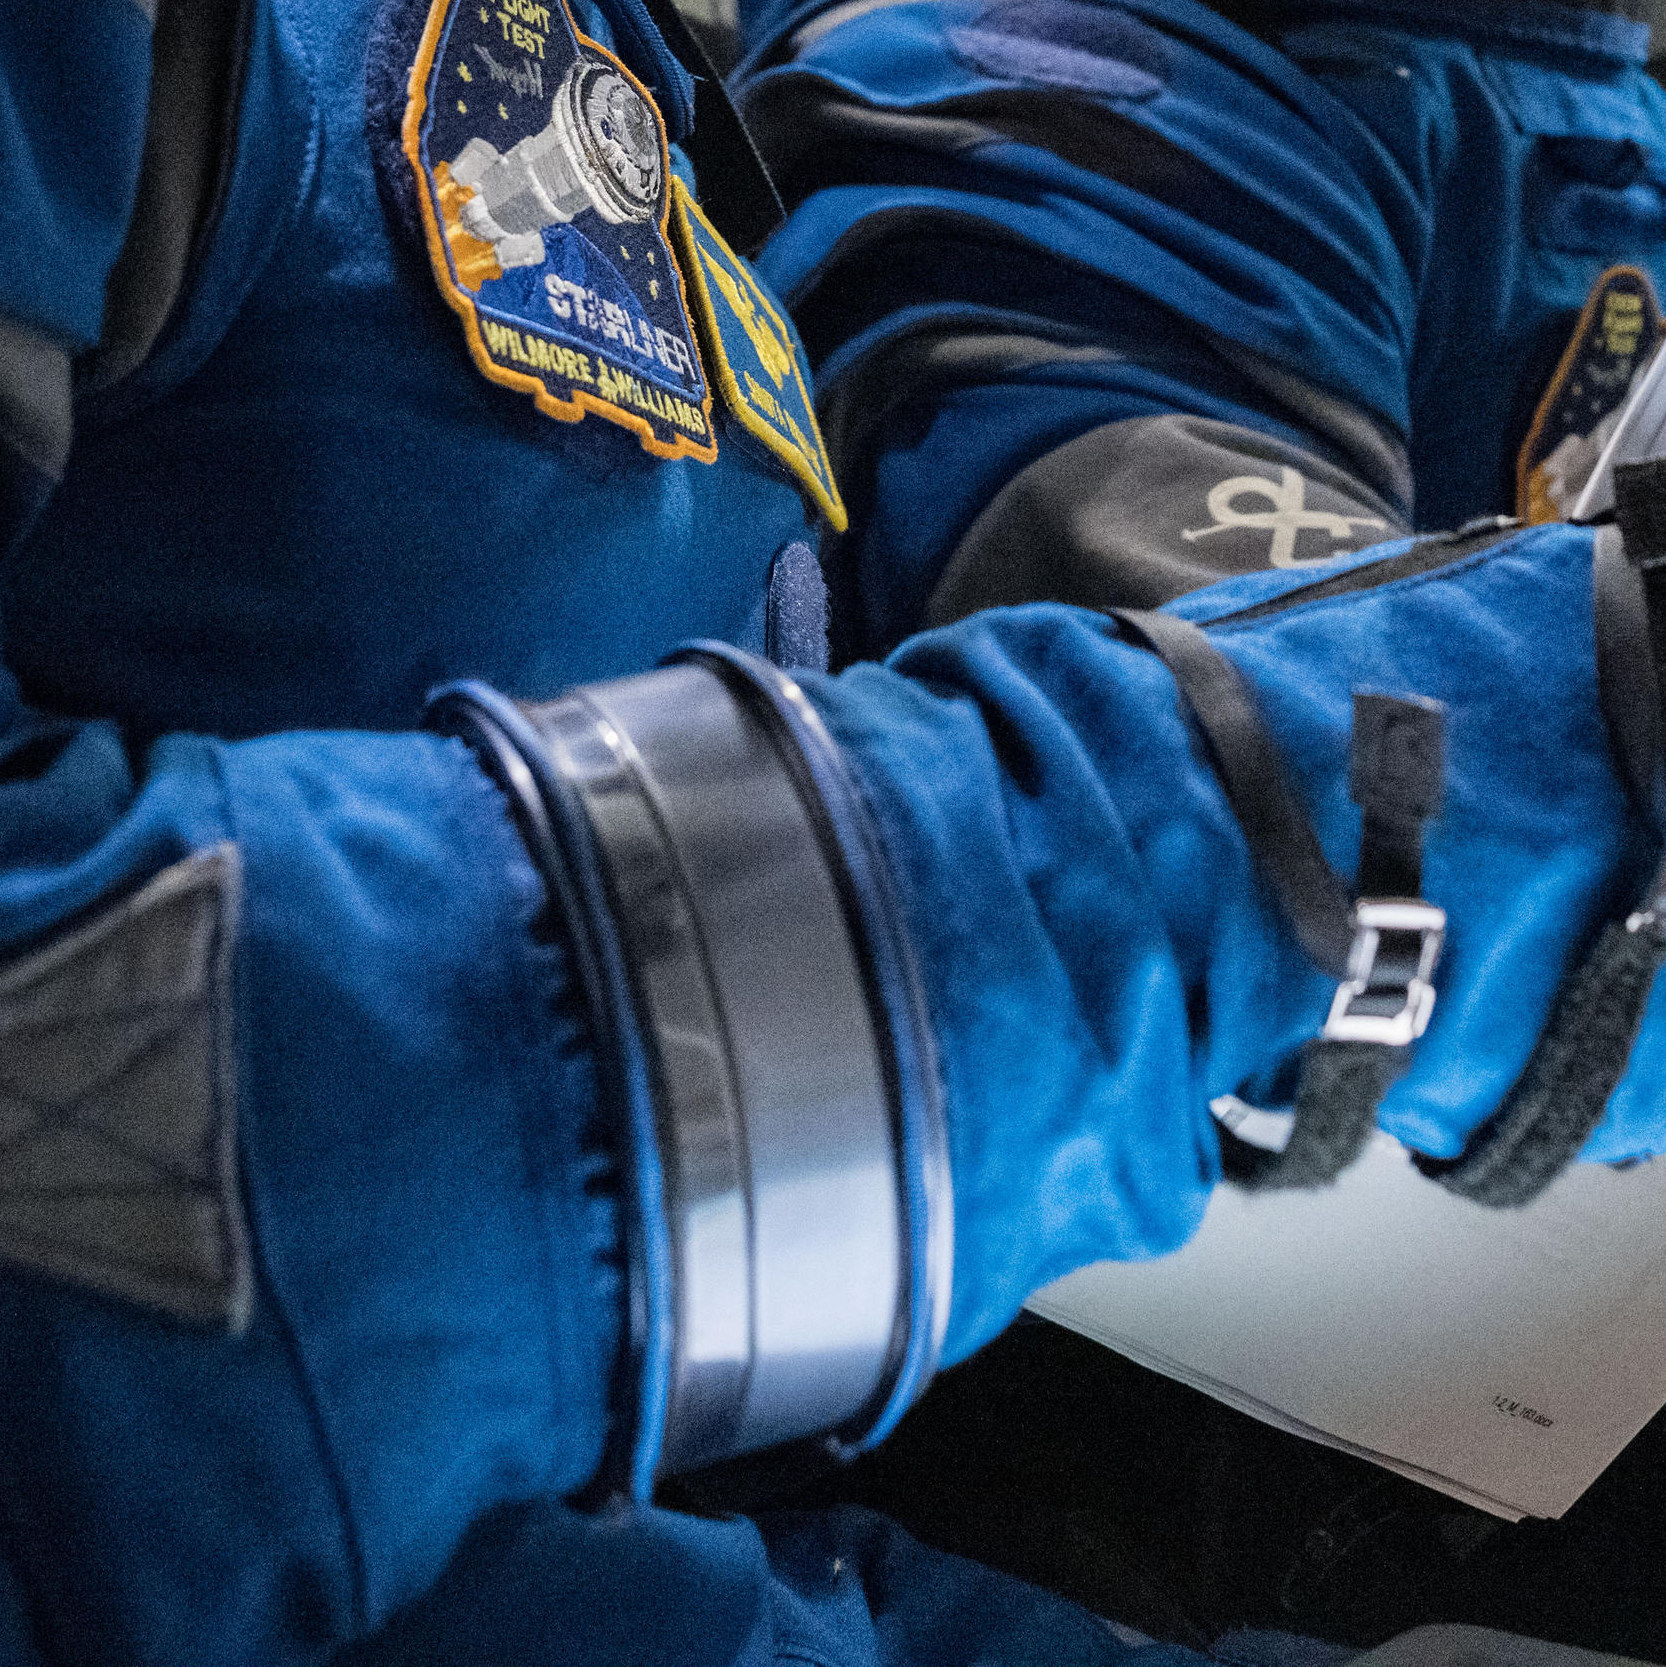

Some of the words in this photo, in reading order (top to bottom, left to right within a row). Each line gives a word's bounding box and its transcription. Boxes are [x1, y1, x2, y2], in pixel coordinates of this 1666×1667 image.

[496, 11, 545, 59] TEST
[483, 319, 595, 383] WILMORE
[611, 367, 706, 435] WILLIAMS
[545, 273, 697, 381] STARLINER
